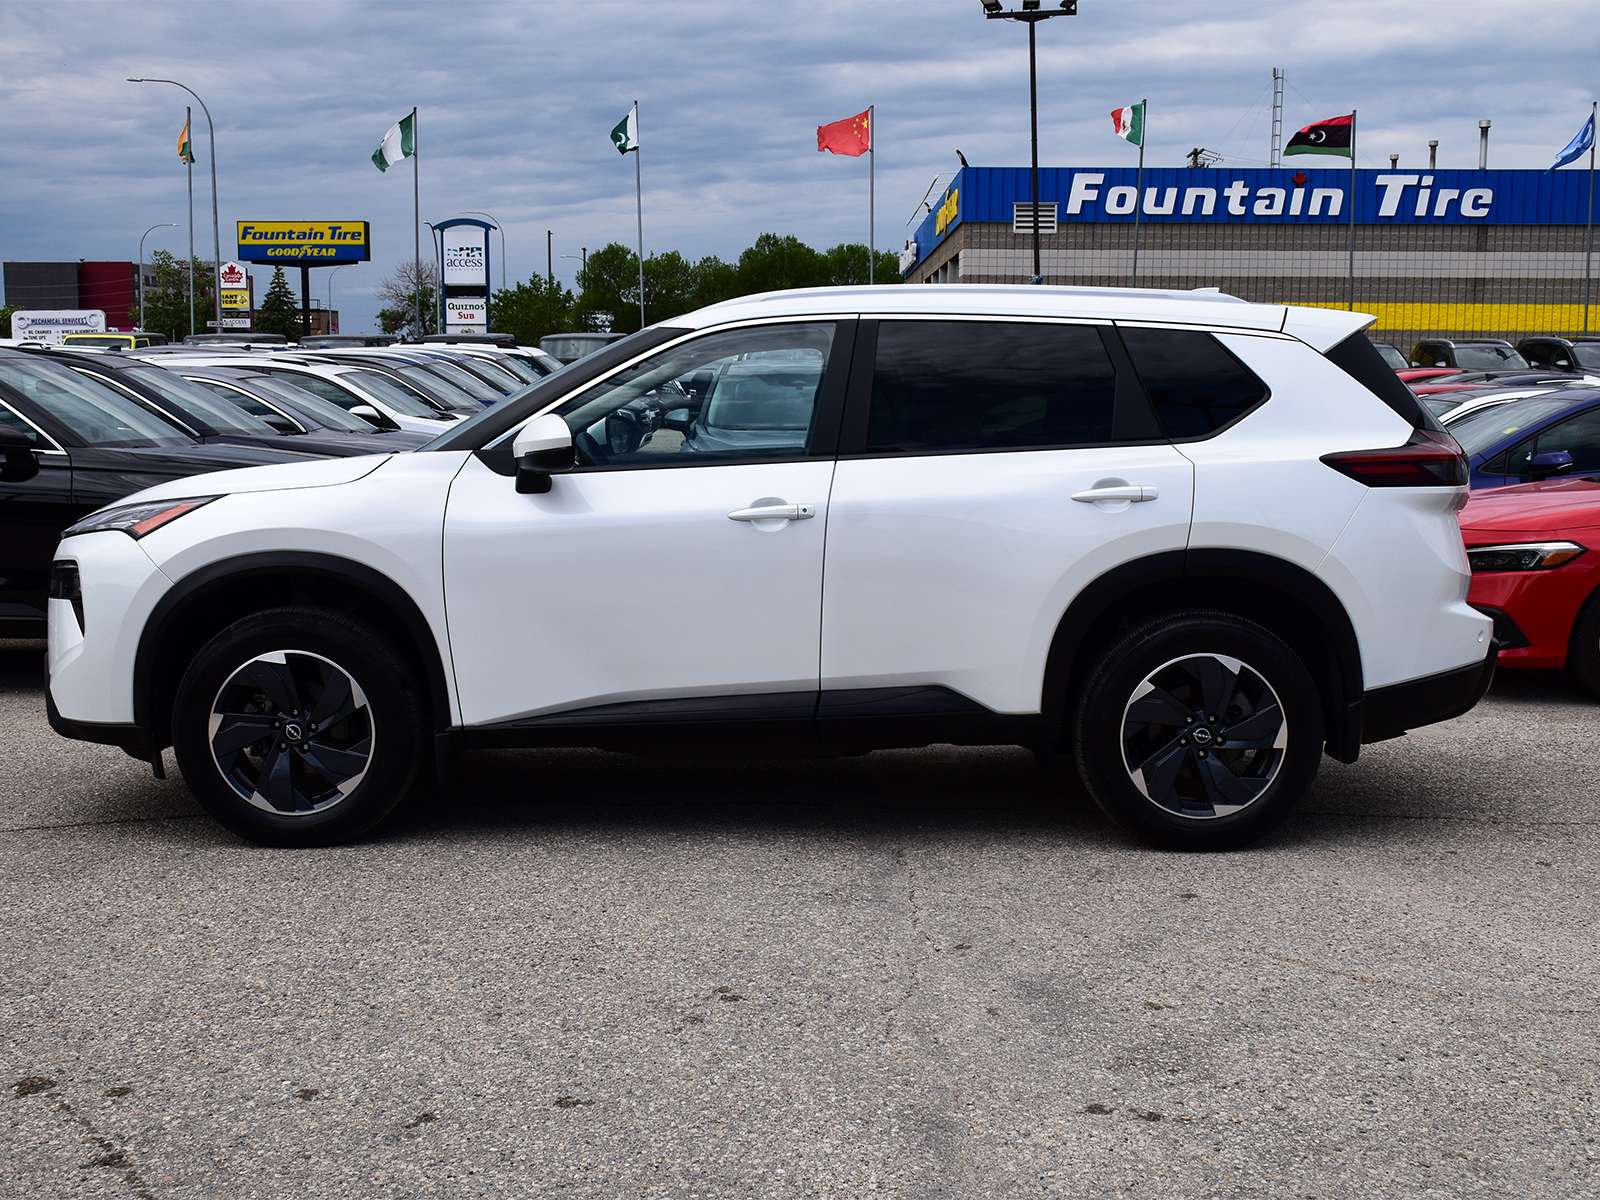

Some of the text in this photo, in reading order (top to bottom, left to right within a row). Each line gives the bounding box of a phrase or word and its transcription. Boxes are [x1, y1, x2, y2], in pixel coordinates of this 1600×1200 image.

[1066, 171, 1494, 218] Fountain Tire
[241, 225, 362, 241] Fountain Tire
[266, 245, 337, 257] GOODYEAR
[446, 258, 483, 268] access
[447, 302, 485, 311] Quiznos
[62, 317, 84, 325] SERVICES
